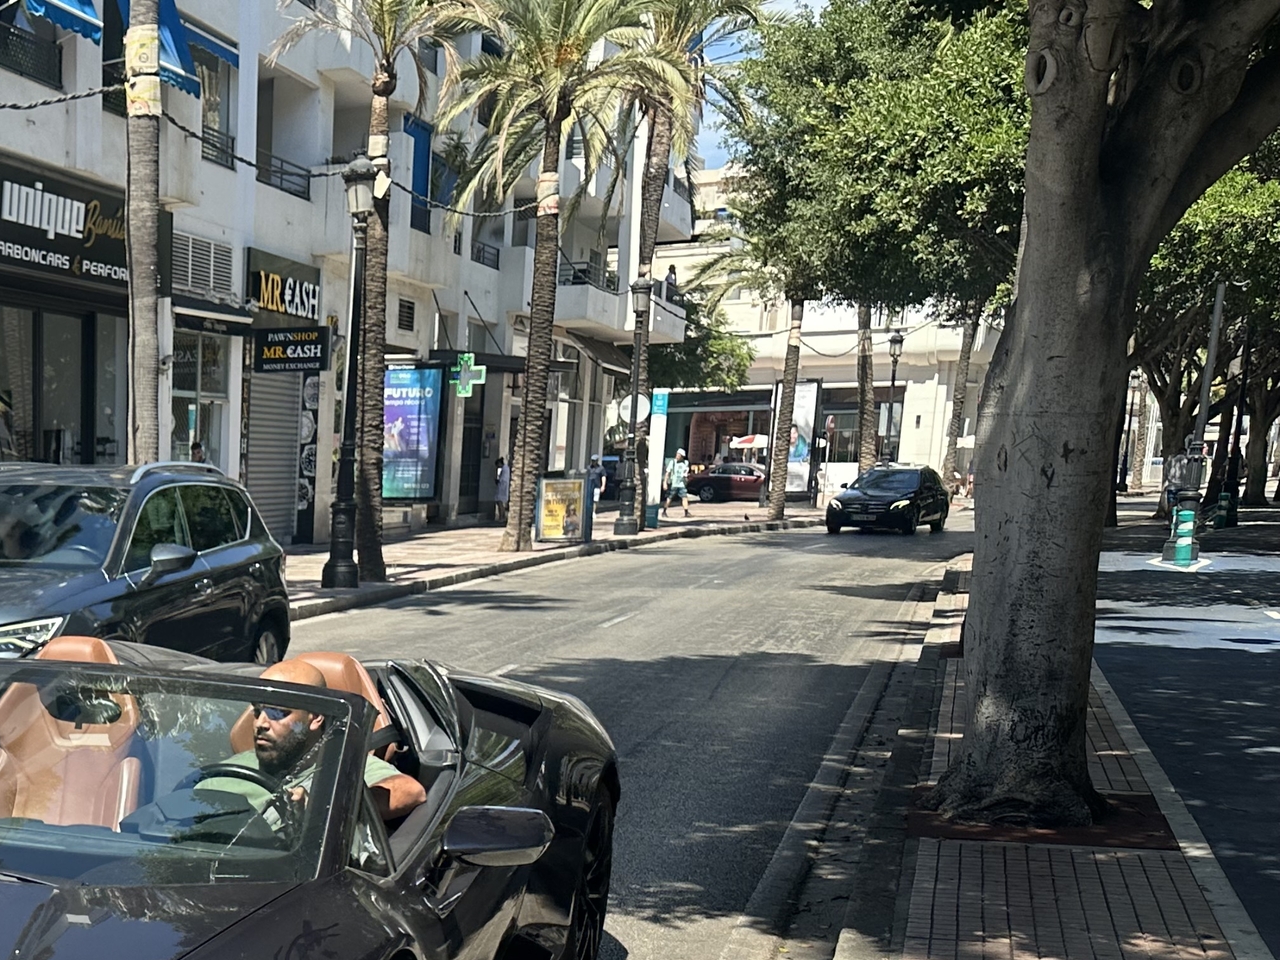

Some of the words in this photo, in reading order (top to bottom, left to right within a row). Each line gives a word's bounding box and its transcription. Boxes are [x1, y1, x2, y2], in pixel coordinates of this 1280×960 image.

[1, 180, 86, 240] unique
[82, 260, 130, 281] PERFOR
[268, 332, 318, 342] PAWNSHOP
